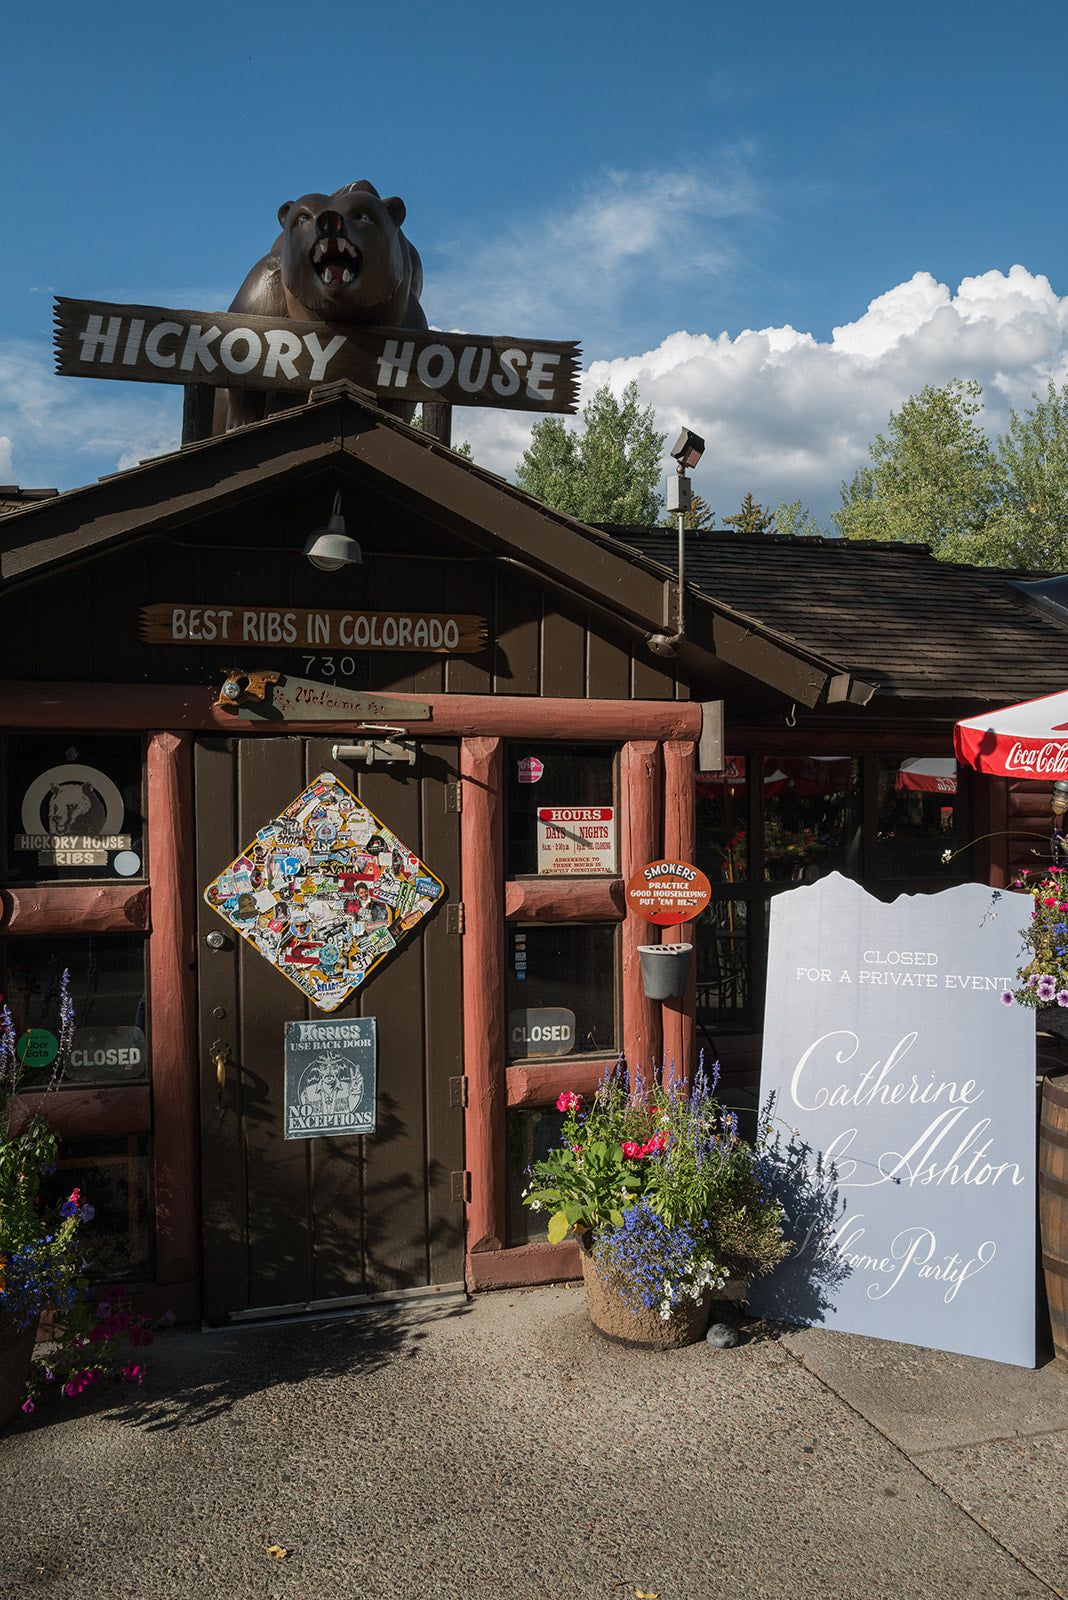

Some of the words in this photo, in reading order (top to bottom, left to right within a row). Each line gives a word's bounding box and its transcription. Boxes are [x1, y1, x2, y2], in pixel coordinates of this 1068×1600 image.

[79, 313, 348, 382] HICKORY
[376, 339, 562, 401] HOUSE
[171, 608, 233, 641] BEST
[243, 611, 297, 644] RIBS
[306, 613, 331, 645] IN
[339, 614, 460, 649] COLORADO
[301, 655, 356, 677] 730
[295, 685, 362, 712] Welcome
[551, 810, 601, 821] HOURS
[546, 826, 566, 840] DAYS
[579, 826, 609, 840] NIGHTS
[21, 836, 79, 850] HICKORY
[82, 835, 124, 849] HOUSE
[55, 852, 95, 864] RIBS
[643, 863, 697, 881] SMOKERS
[630, 889, 651, 897] GOOD
[653, 890, 707, 898] HOUSEKEEPING
[648, 882, 689, 890] PRACTICE
[639, 898, 655, 906] PUT
[863, 950, 938, 966] CLOSED
[796, 967, 832, 983] FOR
[839, 970, 852, 984] A
[858, 971, 937, 988] PRIVATE
[945, 975, 1011, 991] EVENT
[512, 1025, 571, 1043] CLOSED
[290, 1041, 311, 1051] USE
[313, 1040, 341, 1049] BACK
[343, 1038, 371, 1048] DOOR
[70, 1047, 141, 1067] CLOSED
[790, 1030, 985, 1111] Catherine
[289, 1104, 313, 1117] NO
[288, 1112, 372, 1130] EXCEPTIONS
[852, 1105, 1025, 1188] Ashton
[867, 1226, 997, 1304] Party
